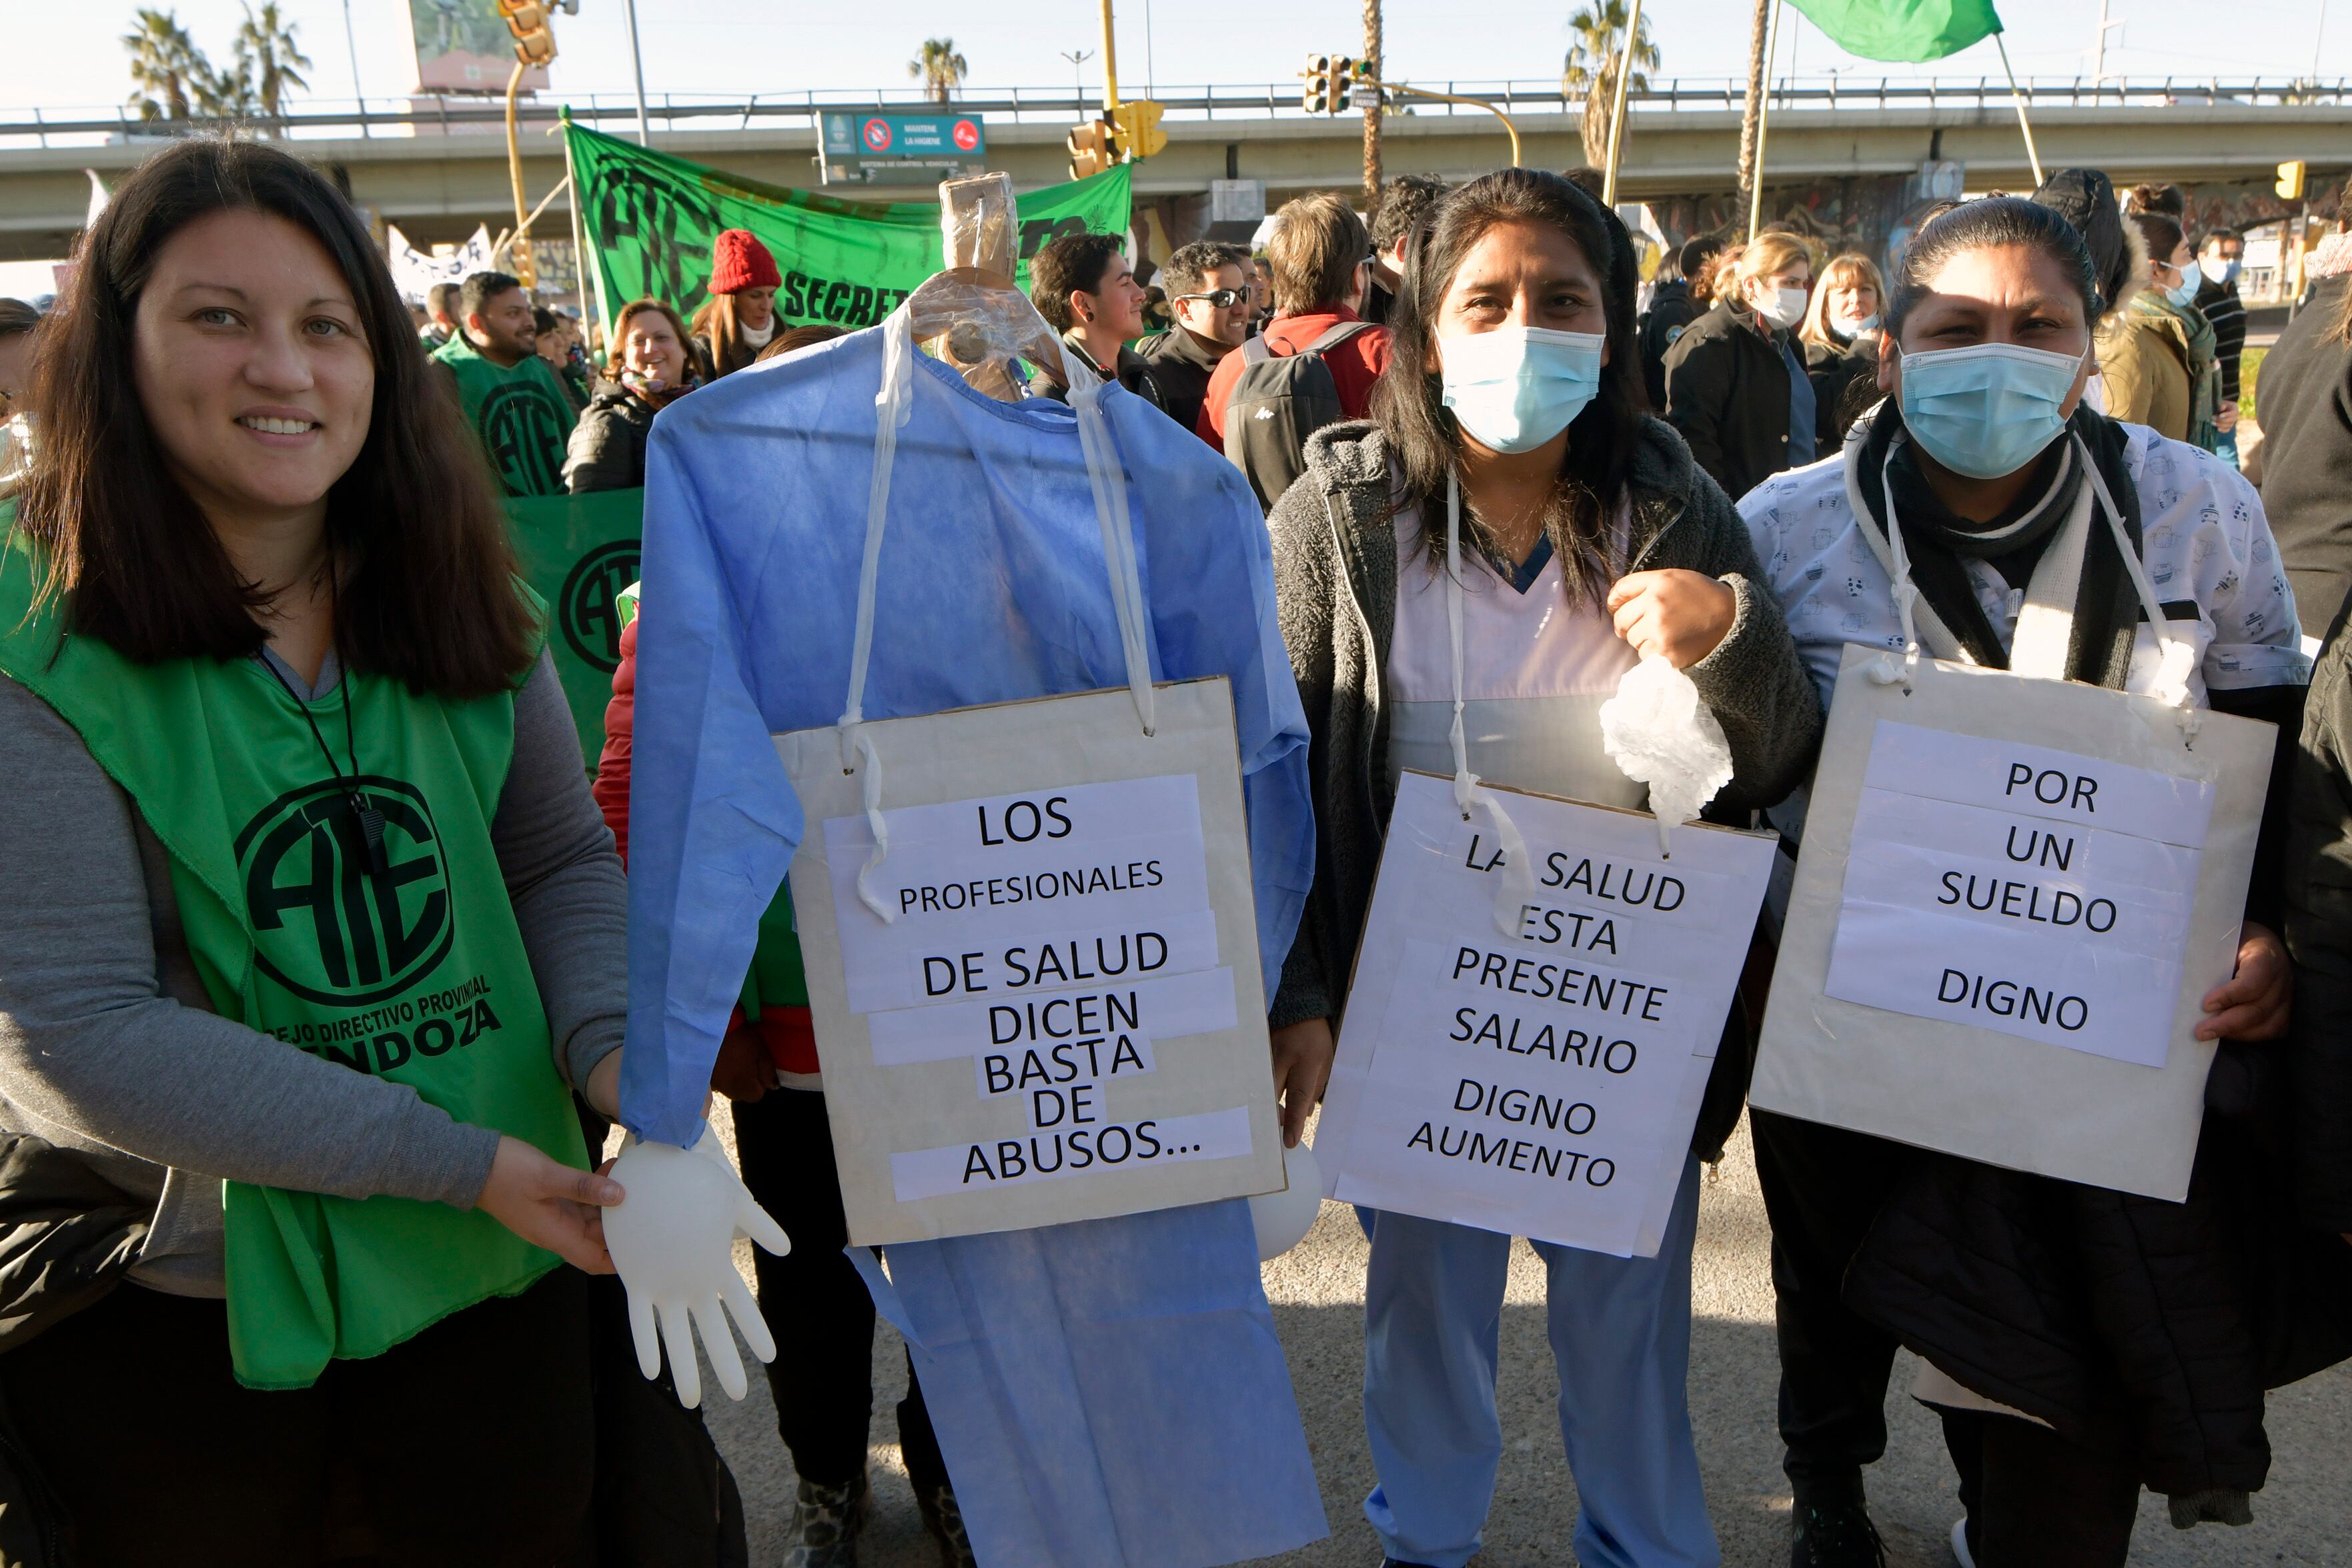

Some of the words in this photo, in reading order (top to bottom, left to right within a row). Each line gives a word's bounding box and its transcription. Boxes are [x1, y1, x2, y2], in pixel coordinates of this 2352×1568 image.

[904, 125, 937, 133] MANTENE
[489, 396, 565, 496] ATE
[2006, 763, 2097, 812] POR
[979, 798, 1071, 845] LOS
[2007, 826, 2073, 870] UN
[246, 792, 448, 988] ATE
[901, 861, 1162, 914] PROFESIONALES
[1541, 852, 1684, 912] SALUD
[1938, 872, 2116, 932] SUELDO
[1524, 906, 1616, 954] ESTA
[924, 952, 987, 996] DE
[1005, 932, 1167, 986] SALUD
[1453, 947, 1668, 1022] PRESENTE
[318, 1002, 414, 1042] DIRECTIVO
[989, 992, 1139, 1044] DICEN
[1938, 969, 2087, 1030] DIGNO
[985, 1034, 1144, 1094] BASTA
[1450, 1007, 1636, 1073] SALARIO
[1034, 1085, 1095, 1127] DE
[1454, 1079, 1596, 1135] DIGNO
[963, 1121, 1199, 1183] ABUSOS...
[1407, 1122, 1614, 1187] AUMENTO
